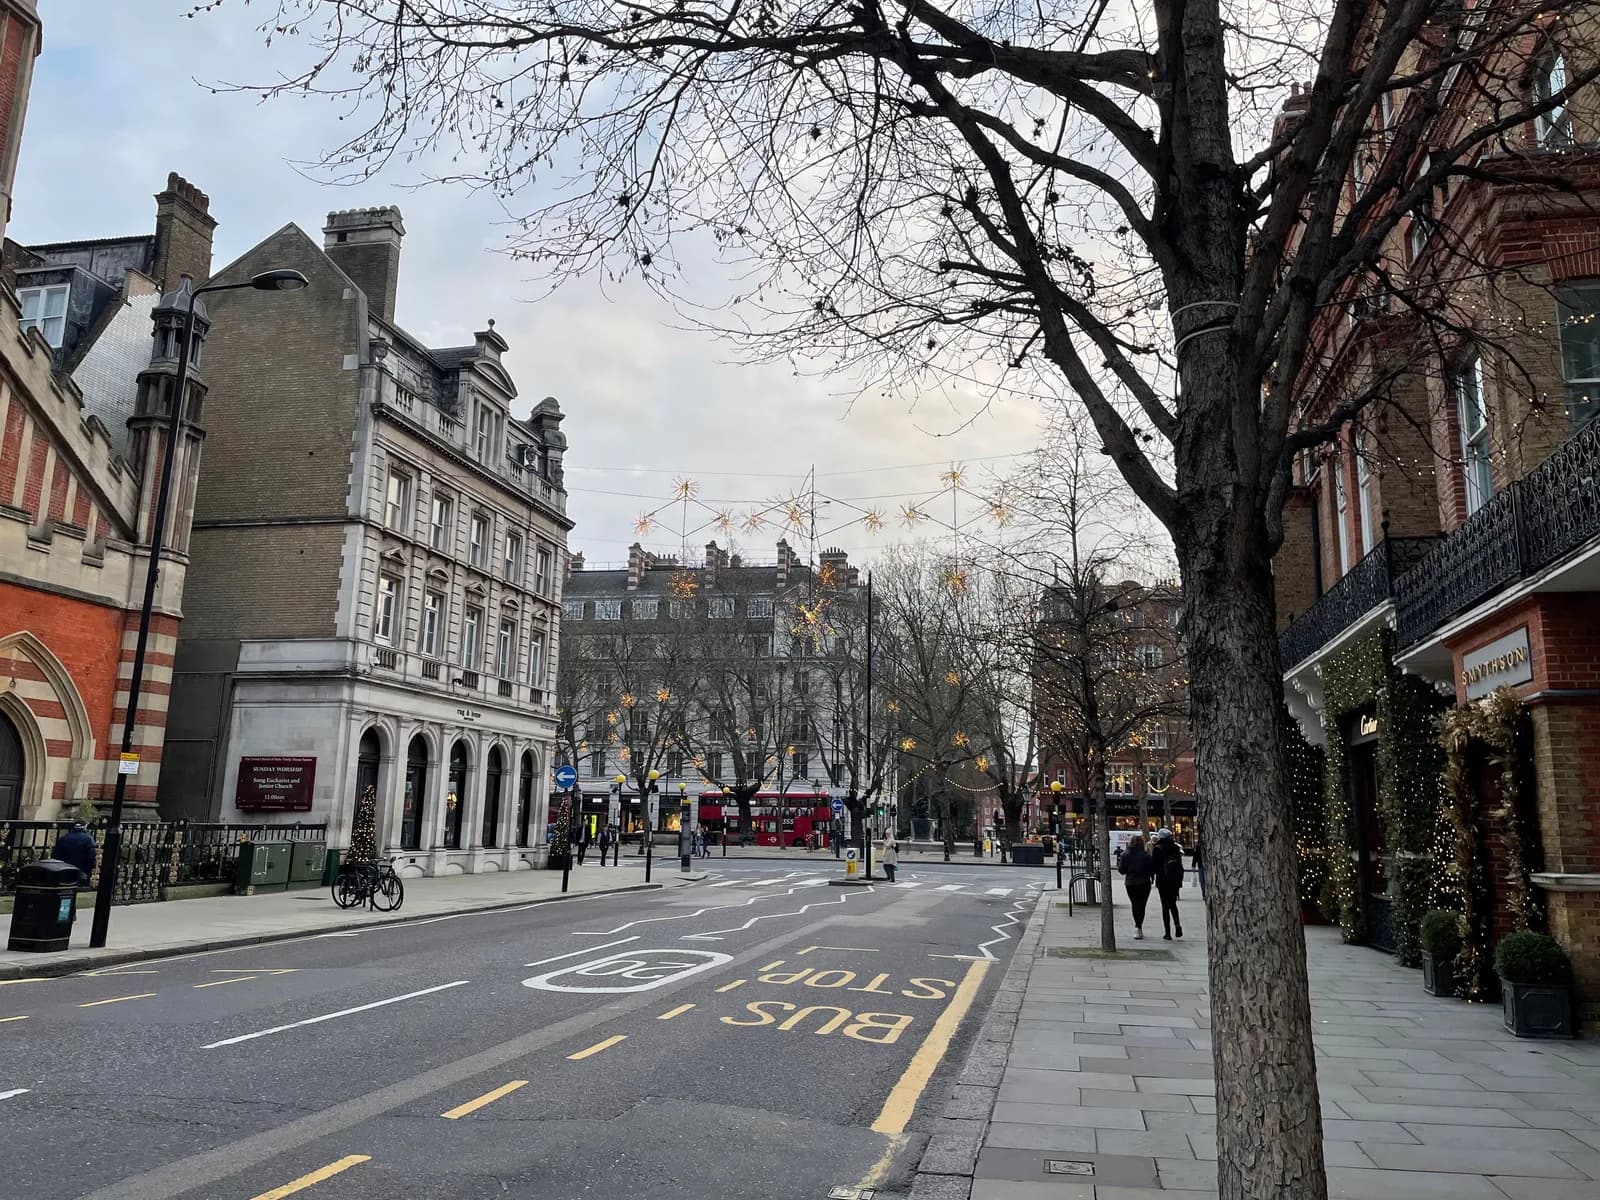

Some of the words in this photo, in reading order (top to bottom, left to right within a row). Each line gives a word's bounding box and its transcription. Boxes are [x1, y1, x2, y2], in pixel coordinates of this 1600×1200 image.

[1461, 647, 1526, 686] SMYTHSON
[575, 960, 697, 979] 20
[757, 967, 957, 1000] STOP
[719, 1001, 914, 1044] BUS
